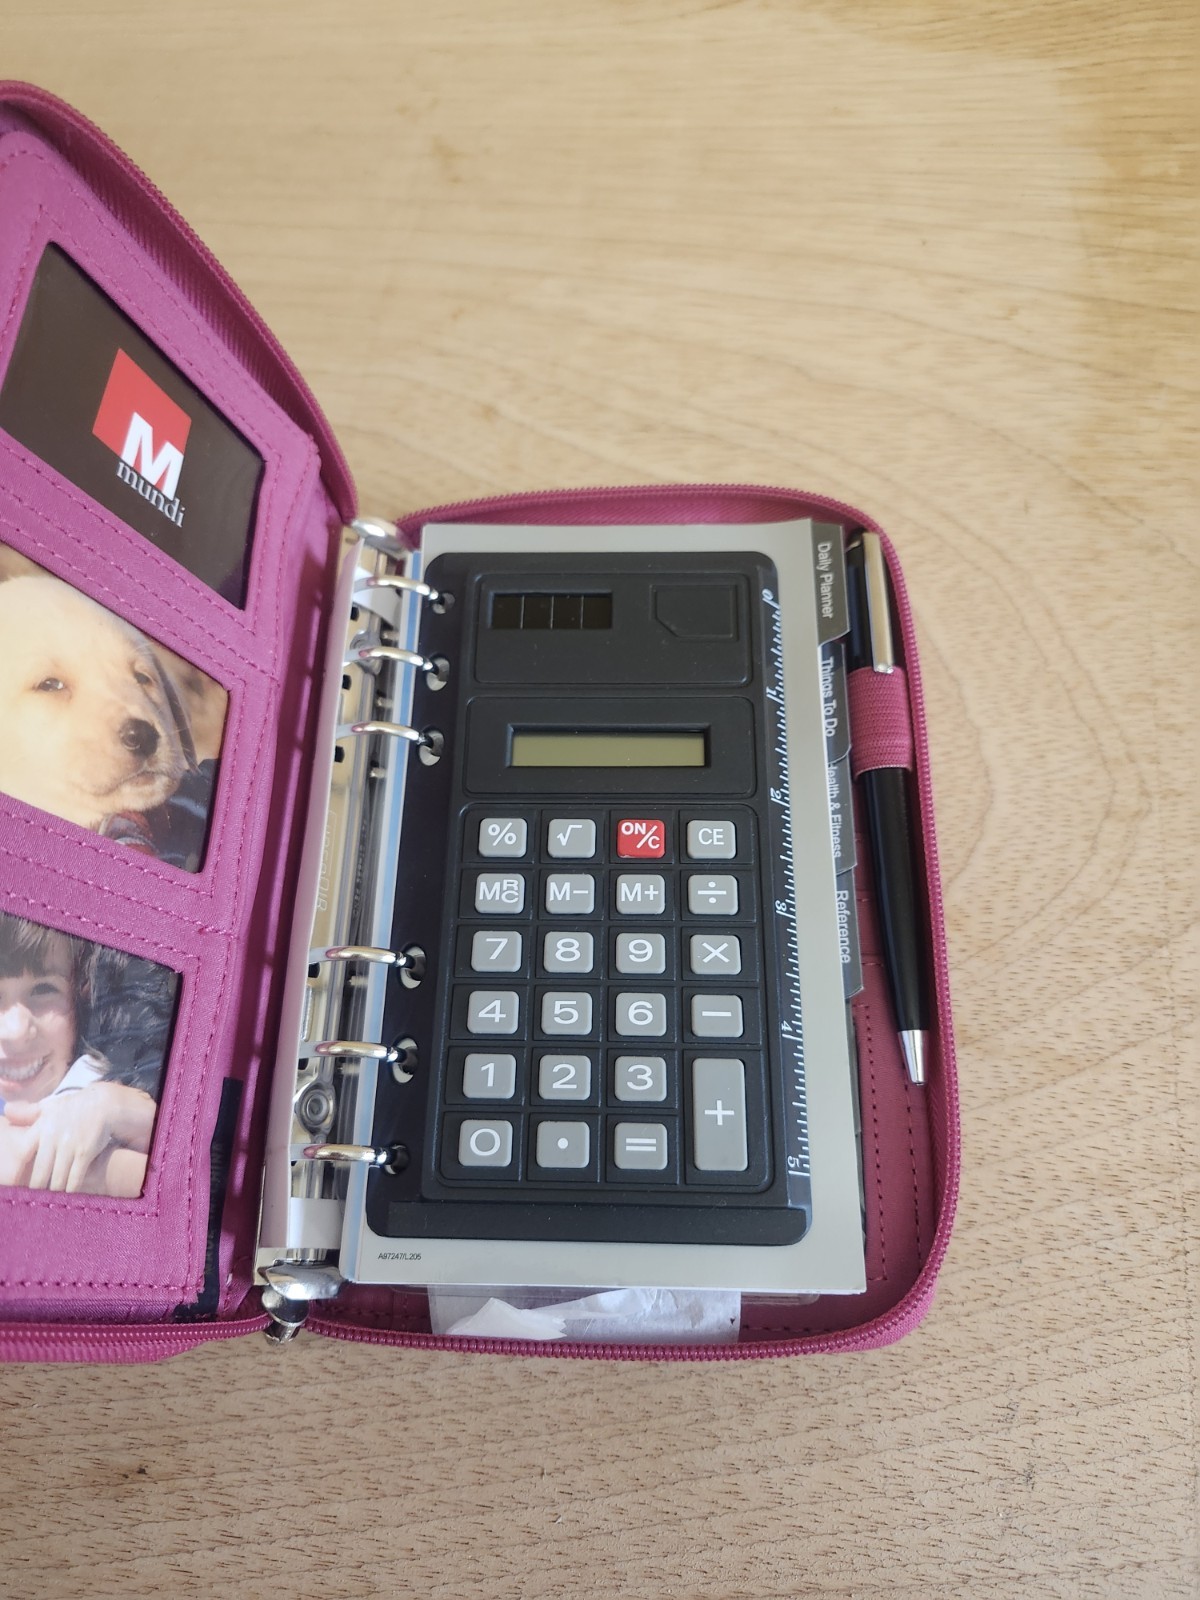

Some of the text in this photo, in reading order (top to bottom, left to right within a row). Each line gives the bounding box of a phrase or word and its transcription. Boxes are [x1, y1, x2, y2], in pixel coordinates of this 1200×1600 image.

[120, 412, 184, 500] M
[116, 461, 185, 527] mundi
[816, 542, 834, 619] Daily Planner
[762, 588, 774, 601] 0
[823, 699, 837, 716] To
[825, 717, 838, 737] Do
[770, 787, 782, 799] 2
[830, 802, 841, 811] &
[488, 822, 517, 846] %
[698, 828, 725, 845] CE
[621, 882, 659, 902] M+
[775, 900, 787, 912] 3
[835, 890, 851, 963] Reference
[486, 938, 508, 960] 7
[555, 938, 580, 962] 8
[628, 939, 653, 963] 9
[478, 1000, 506, 1022] 4
[553, 1001, 579, 1024] 5
[628, 1001, 653, 1025] 6
[781, 1020, 793, 1031] 4
[480, 1062, 495, 1087] 1
[552, 1063, 577, 1089] 2
[627, 1065, 654, 1090] 3
[470, 1128, 500, 1156] 0
[788, 1155, 800, 1168] 5
